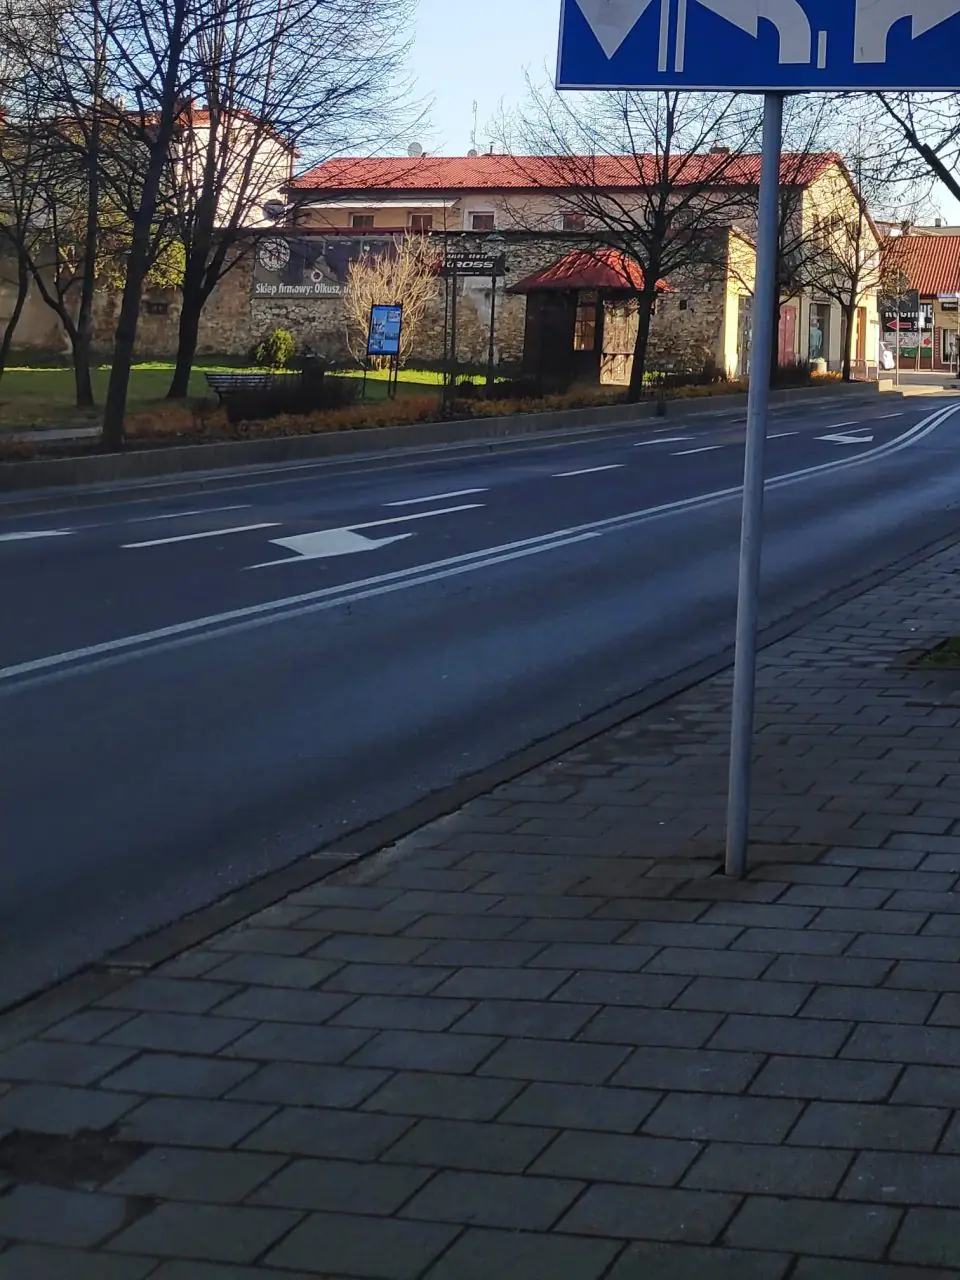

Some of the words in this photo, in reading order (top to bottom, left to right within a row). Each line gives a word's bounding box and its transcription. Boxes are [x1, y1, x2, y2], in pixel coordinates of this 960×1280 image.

[255, 283, 277, 295] Sklep
[278, 283, 313, 295] firmowy:
[314, 283, 341, 294] Olkusz,
